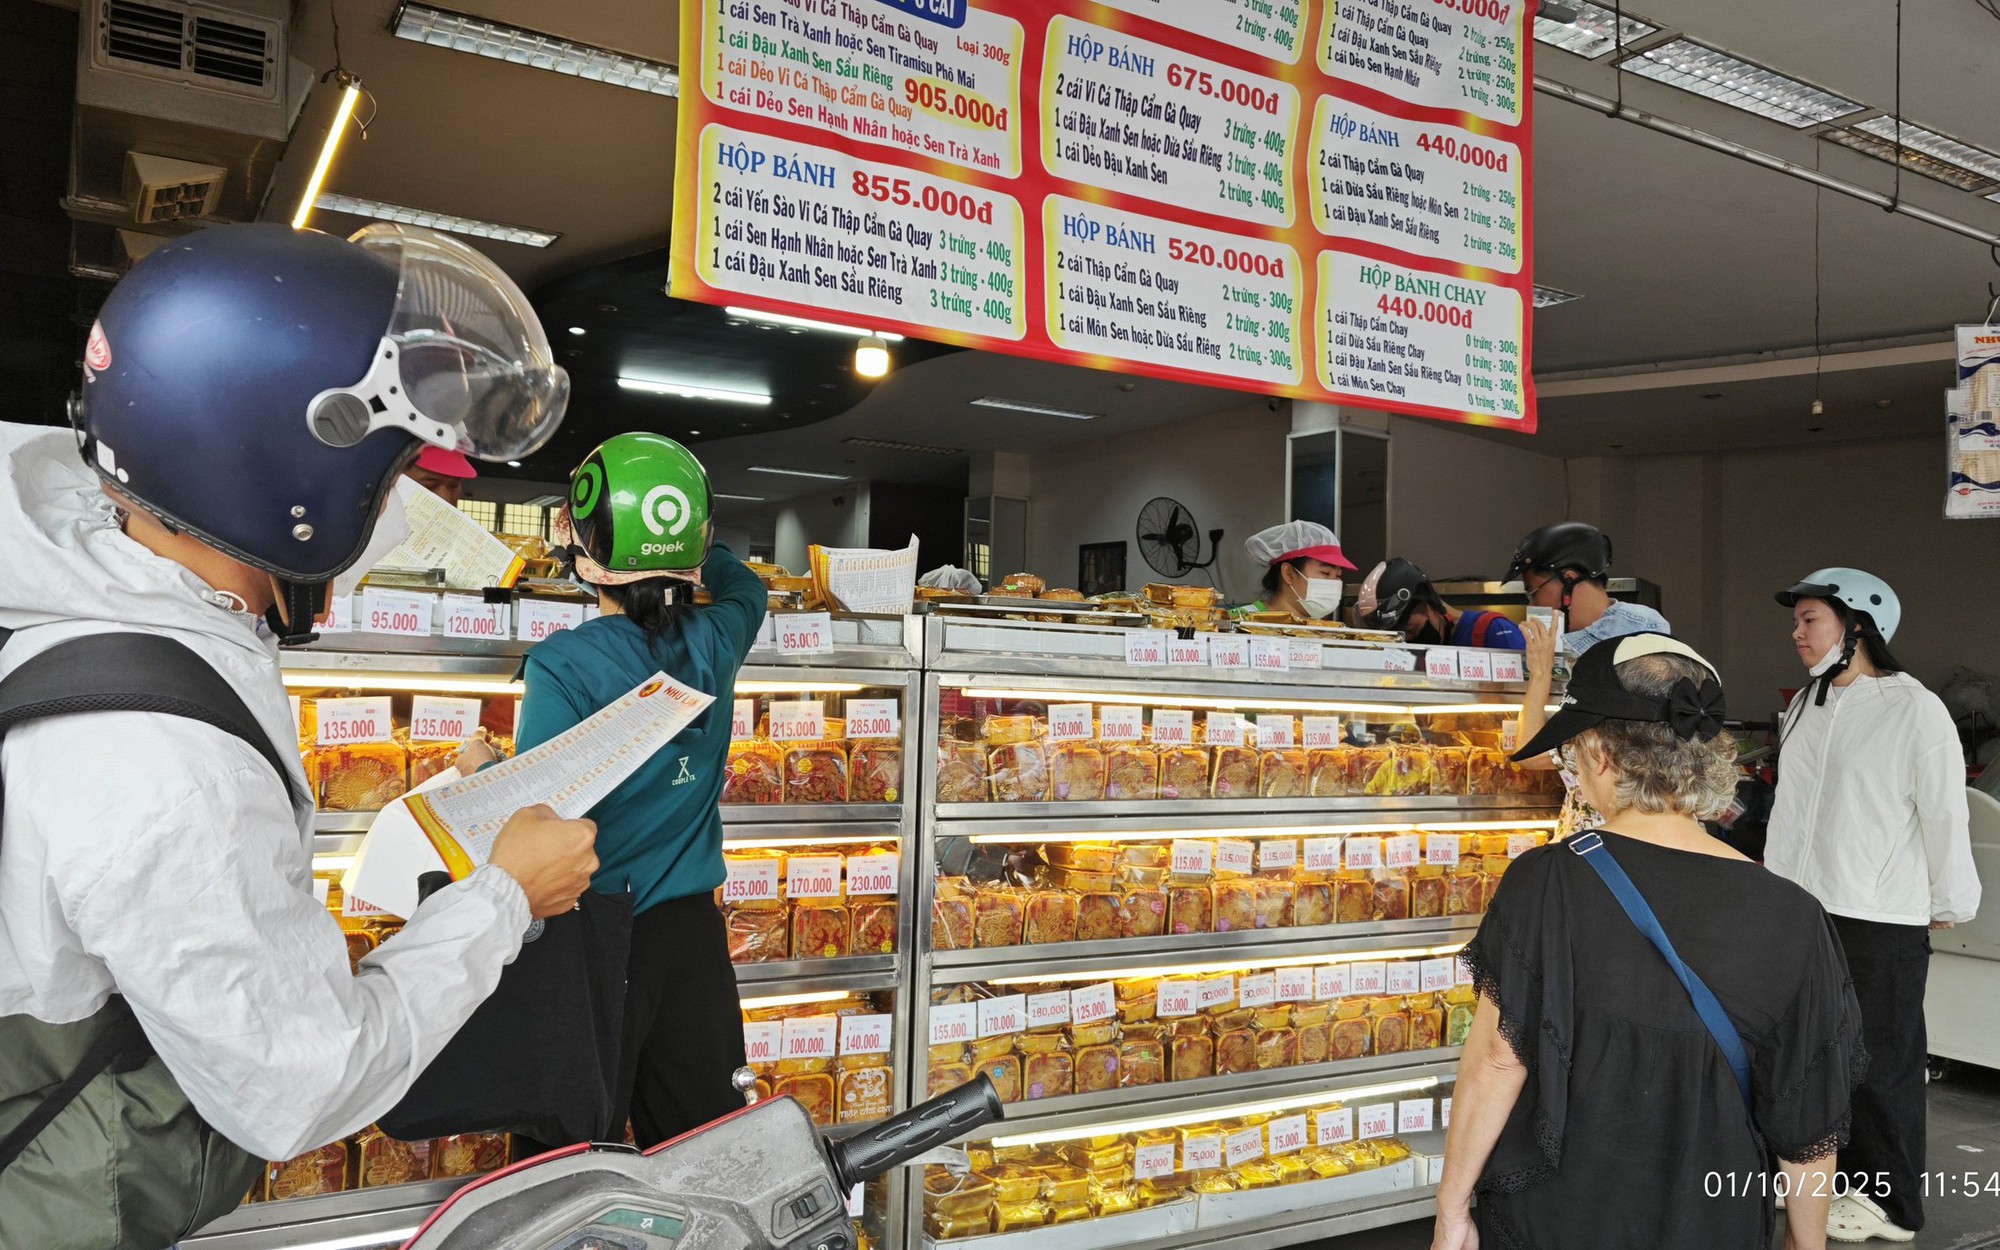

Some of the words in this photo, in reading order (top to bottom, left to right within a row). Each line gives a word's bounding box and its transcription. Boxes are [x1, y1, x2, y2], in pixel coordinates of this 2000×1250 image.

[719, 0, 725, 14] 1
[730, 1, 748, 20] cái
[754, 4, 776, 26] Sen
[780, 11, 799, 33] Trà
[803, 20, 830, 44] Xanh
[836, 28, 863, 54] hoặc
[867, 38, 885, 59] Sen
[889, 45, 932, 75] Tiramisu
[936, 62, 954, 82] Phô
[958, 70, 975, 89] Mai
[956, 36, 978, 56] Loại
[983, 44, 1010, 66] 300g
[719, 26, 725, 43] 1
[730, 31, 748, 49] cái
[752, 34, 776, 58] Đậu
[782, 40, 809, 64] Xanh
[812, 52, 832, 73] Sen
[836, 56, 858, 78] Sầu
[863, 64, 893, 91] Riêng
[1067, 34, 1104, 63] HỘP
[1108, 45, 1154, 77] BÁNH
[1167, 63, 1279, 115] 675.000đ
[905, 78, 1007, 132] 905.000đ
[717, 82, 724, 99] 1
[730, 88, 750, 106] cái
[756, 90, 783, 113] Dẻo
[788, 98, 813, 119] Sen
[818, 105, 848, 130] Hạnh
[853, 116, 887, 138] Nhân
[892, 124, 920, 149] hoặc
[924, 134, 944, 154] Sen
[949, 140, 968, 160] Trà
[973, 147, 1000, 170] Xanh
[1330, 113, 1356, 140] HỘP
[1359, 122, 1400, 147] BÁNH
[1416, 133, 1508, 172] 440.000đ
[718, 142, 765, 175] HỘP
[773, 153, 835, 188] BÁNH
[852, 170, 993, 225] 855.000đ
[714, 182, 721, 203] 2
[725, 186, 742, 208] cái
[747, 190, 768, 214] Yến
[773, 194, 795, 218] Sào
[800, 199, 809, 221] Vi
[814, 203, 827, 225] Cá
[832, 206, 860, 236] Thập
[864, 212, 886, 238] Cẩm
[889, 220, 901, 241] Gà
[906, 224, 932, 250] Quay
[940, 230, 946, 249] 3
[950, 232, 976, 260] trứng
[987, 241, 1011, 267] 400g
[1063, 213, 1100, 243] HỘP
[1106, 222, 1155, 254] BÁNH
[1168, 238, 1284, 278] 520.000đ
[714, 216, 720, 237] 1
[725, 220, 742, 241] cái
[747, 223, 766, 247] Sen
[771, 228, 801, 255] Hạnh
[806, 234, 833, 259] Nhân
[838, 241, 863, 270] hoặc
[867, 246, 886, 270] Sen
[890, 252, 906, 274] Trà
[911, 256, 936, 279] Xanh
[941, 262, 947, 281] 3
[951, 264, 977, 291] trứng
[988, 272, 1013, 297] 400g
[713, 247, 720, 268] 1
[725, 251, 745, 272] cái
[750, 254, 774, 281] Đậu
[780, 260, 810, 284] Xanh
[814, 266, 837, 289] Sen
[868, 276, 902, 304] Riêng
[930, 289, 937, 307] 3
[941, 291, 972, 318] trứng
[984, 299, 1012, 324] 400g
[1058, 251, 1064, 269] 2
[1068, 254, 1083, 273] cái
[1086, 258, 1110, 281] Thập
[1114, 262, 1136, 285] Cẩm
[1139, 268, 1151, 287] Gà
[1155, 272, 1179, 294] Quay
[1223, 285, 1229, 300] 2
[1232, 287, 1260, 308] trứng
[1270, 292, 1293, 313] 300g
[1360, 264, 1391, 290] HỘP
[1395, 273, 1440, 298] BÁNH
[1444, 284, 1486, 306] CHAY
[1377, 294, 1472, 329] 440.000đ
[1327, 309, 1332, 322] 1
[1335, 311, 1348, 325] cái
[1350, 313, 1367, 332] Thập
[1370, 315, 1387, 334] Cẩm
[1390, 320, 1408, 338] Chay
[1975, 336, 2000, 344] NH
[641, 541, 685, 555] gojek
[371, 611, 417, 632] 95.000
[448, 616, 496, 634] 120.000
[783, 632, 819, 648] 95.000
[1130, 649, 1158, 662] 120.000
[1171, 649, 1199, 663] 120.000
[324, 720, 375, 740] 135.000
[413, 718, 462, 737] 135.000
[772, 721, 816, 738] 215.000
[851, 718, 890, 734] 285.000
[1053, 721, 1083, 736] 150.000
[1102, 723, 1132, 737] 150.000
[1155, 727, 1182, 740] 150.000
[1175, 856, 1202, 870] 115.000
[726, 880, 768, 896] 155.000
[791, 877, 832, 894] 170.000
[851, 875, 892, 892] 230.000
[1281, 984, 1304, 997] 85.000
[1076, 1001, 1106, 1020] 125.000
[1163, 998, 1188, 1012] 85.000
[934, 1023, 966, 1040] 155.000
[984, 1015, 1015, 1032] 170.000
[790, 1037, 824, 1054] 100.000
[846, 1034, 879, 1050] 140.000
[1321, 1126, 1344, 1142] 75.000
[1363, 1120, 1386, 1135] 75.000
[1274, 1132, 1299, 1149] 75.000
